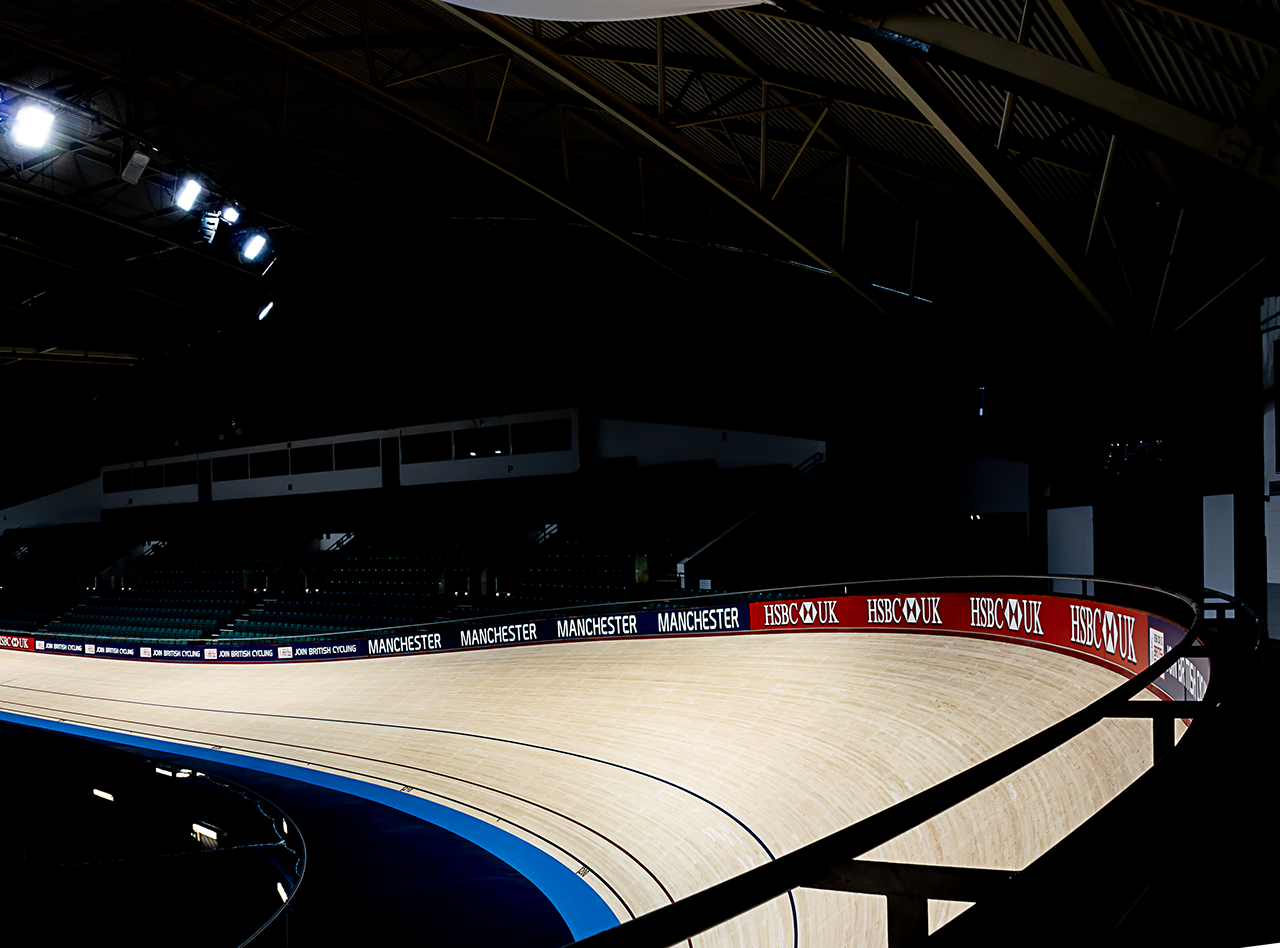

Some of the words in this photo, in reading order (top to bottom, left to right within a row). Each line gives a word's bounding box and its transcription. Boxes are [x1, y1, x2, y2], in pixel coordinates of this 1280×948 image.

[658, 608, 739, 632] MANCHESTER
[764, 604, 798, 626] HSBC
[818, 601, 839, 624] UK
[867, 599, 902, 624] HSBC
[922, 598, 942, 624] UK
[970, 598, 1004, 630] HSBC
[1022, 600, 1043, 635] UK
[460, 623, 536, 646] MANCHESTER
[557, 614, 637, 638] MANCHESTER
[1070, 605, 1101, 649] HSBC
[1118, 614, 1137, 664] UK
[19, 638, 28, 648] UK
[119, 647, 134, 655] CYCLING
[294, 648, 307, 656] JOIN
[308, 646, 331, 656] BRITISH
[333, 644, 356, 654] CYCLING
[368, 633, 441, 654] MANCHESTER
